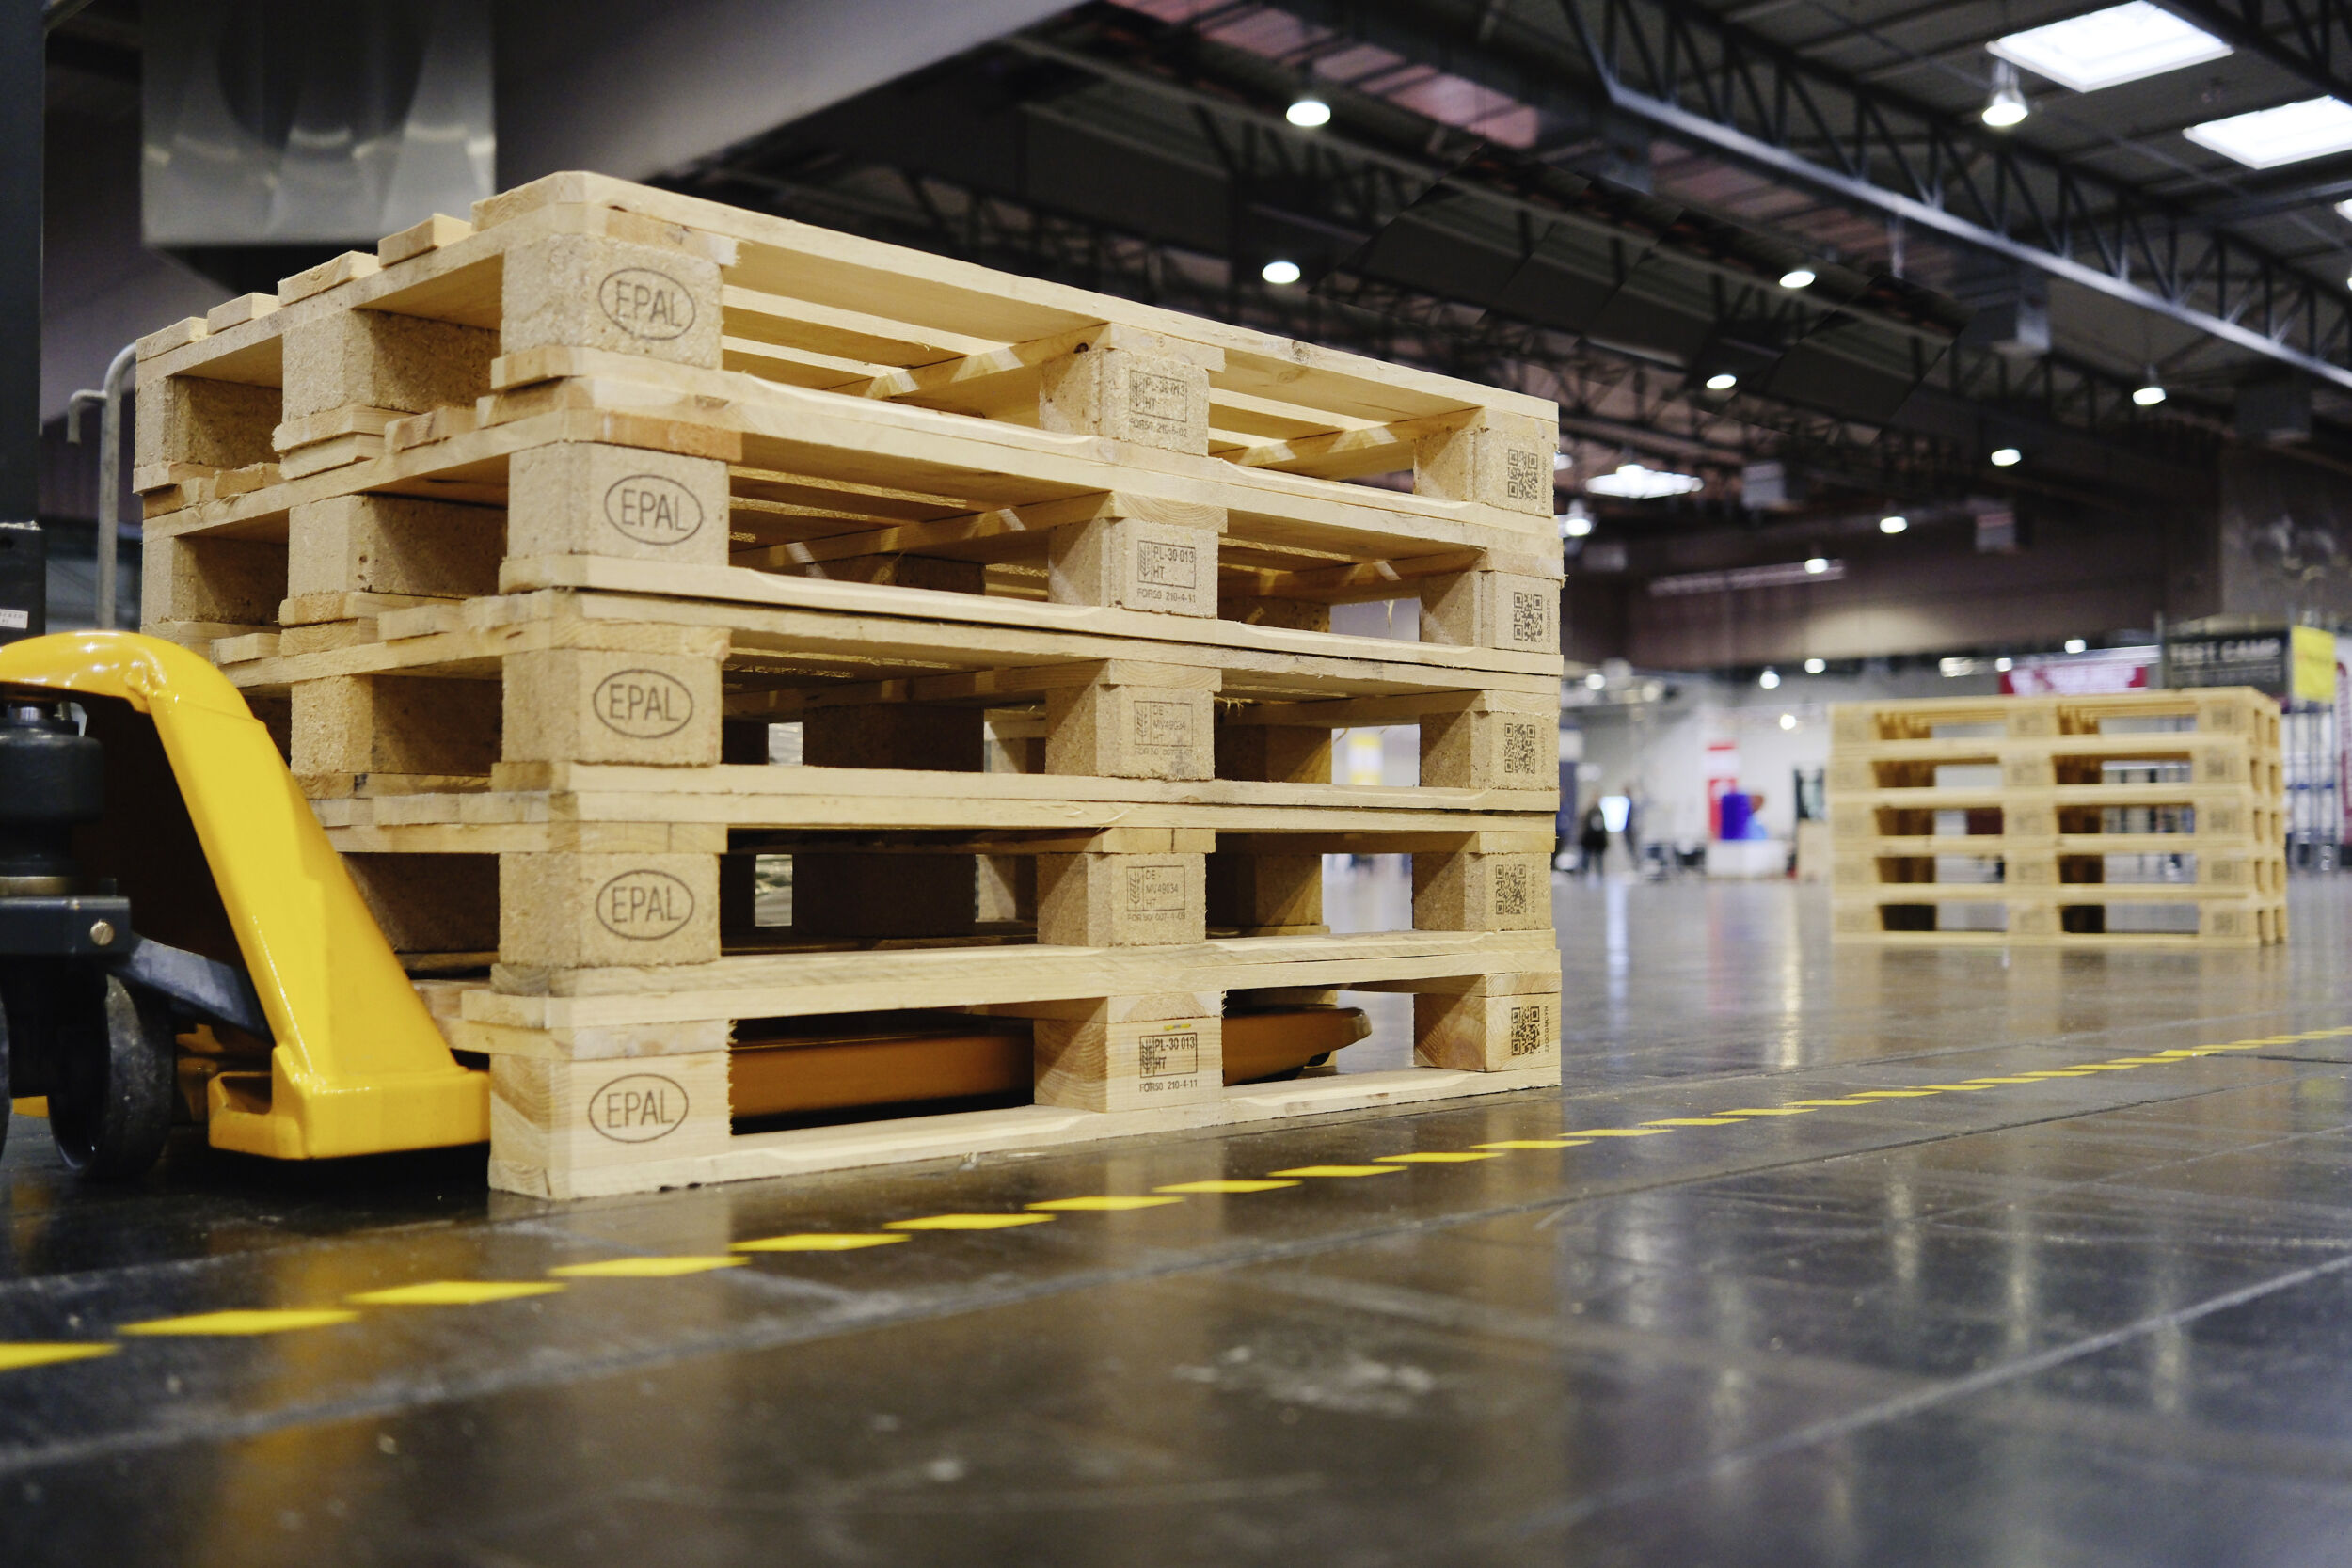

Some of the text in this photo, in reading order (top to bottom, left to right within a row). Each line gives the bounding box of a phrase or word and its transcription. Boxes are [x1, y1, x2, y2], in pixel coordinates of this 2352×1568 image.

[616, 280, 682, 327] EPAL
[1145, 397, 1156, 409] HT
[622, 488, 689, 531] EPAL
[1153, 565, 1165, 580] HT
[609, 683, 680, 721] EPAL
[612, 885, 682, 923] EPAL
[1146, 899, 1157, 909] HT
[1154, 1037, 1195, 1051] PL-30 013
[1154, 1057, 1167, 1069] HT
[607, 1088, 675, 1129] EPAL
